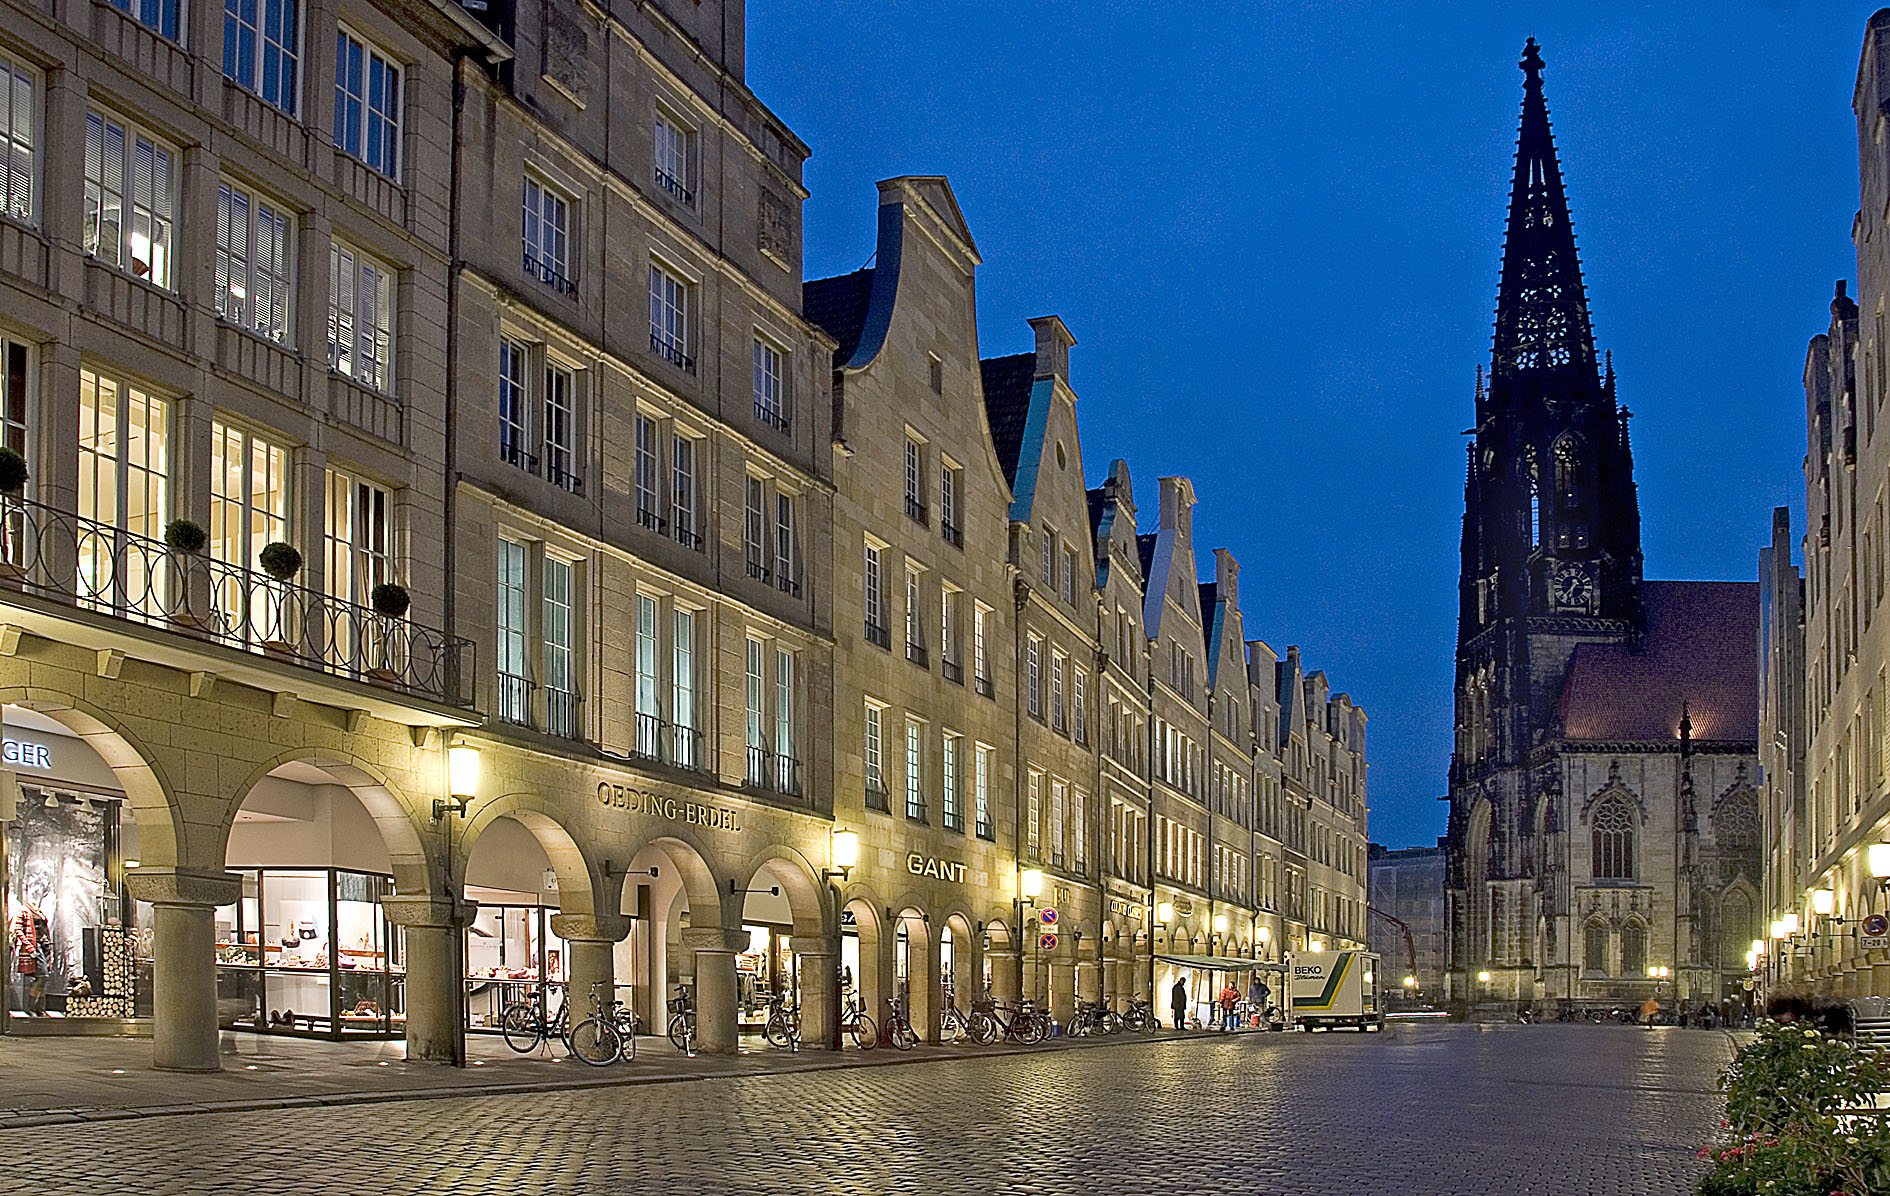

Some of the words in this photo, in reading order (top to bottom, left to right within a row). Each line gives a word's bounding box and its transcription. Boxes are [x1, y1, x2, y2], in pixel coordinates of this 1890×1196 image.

[2, 739, 52, 769] GER
[597, 781, 742, 832] OEDING-ERDEL
[906, 852, 968, 884] GANT
[1294, 966, 1322, 975] BEKO
